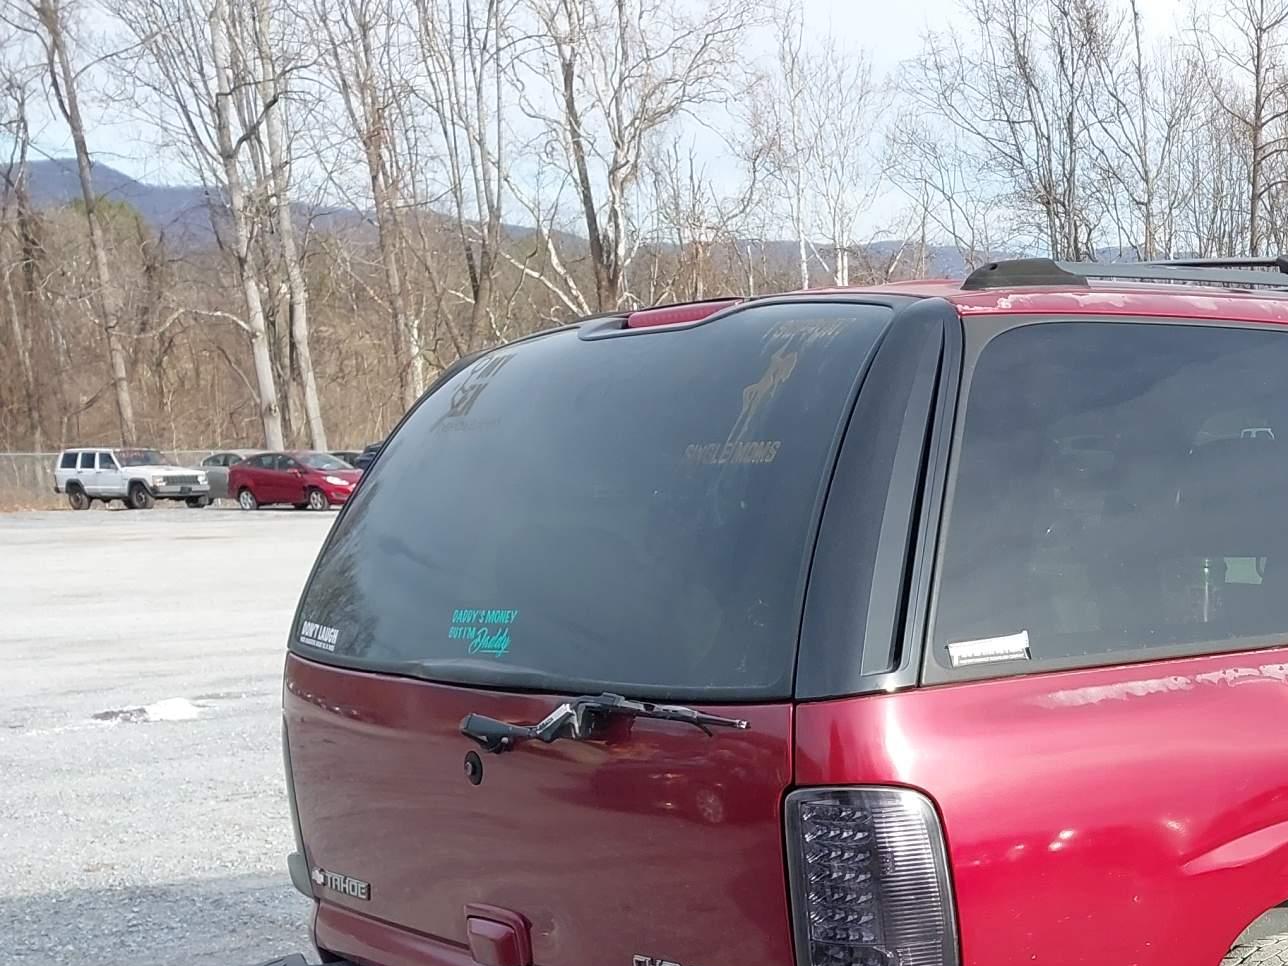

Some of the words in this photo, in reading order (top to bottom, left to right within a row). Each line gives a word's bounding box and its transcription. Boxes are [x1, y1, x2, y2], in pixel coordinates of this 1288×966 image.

[451, 608, 485, 624] DADDY'S
[484, 608, 518, 624] MONEY
[317, 625, 340, 645] LAUGH
[325, 870, 369, 900] TAHOE
